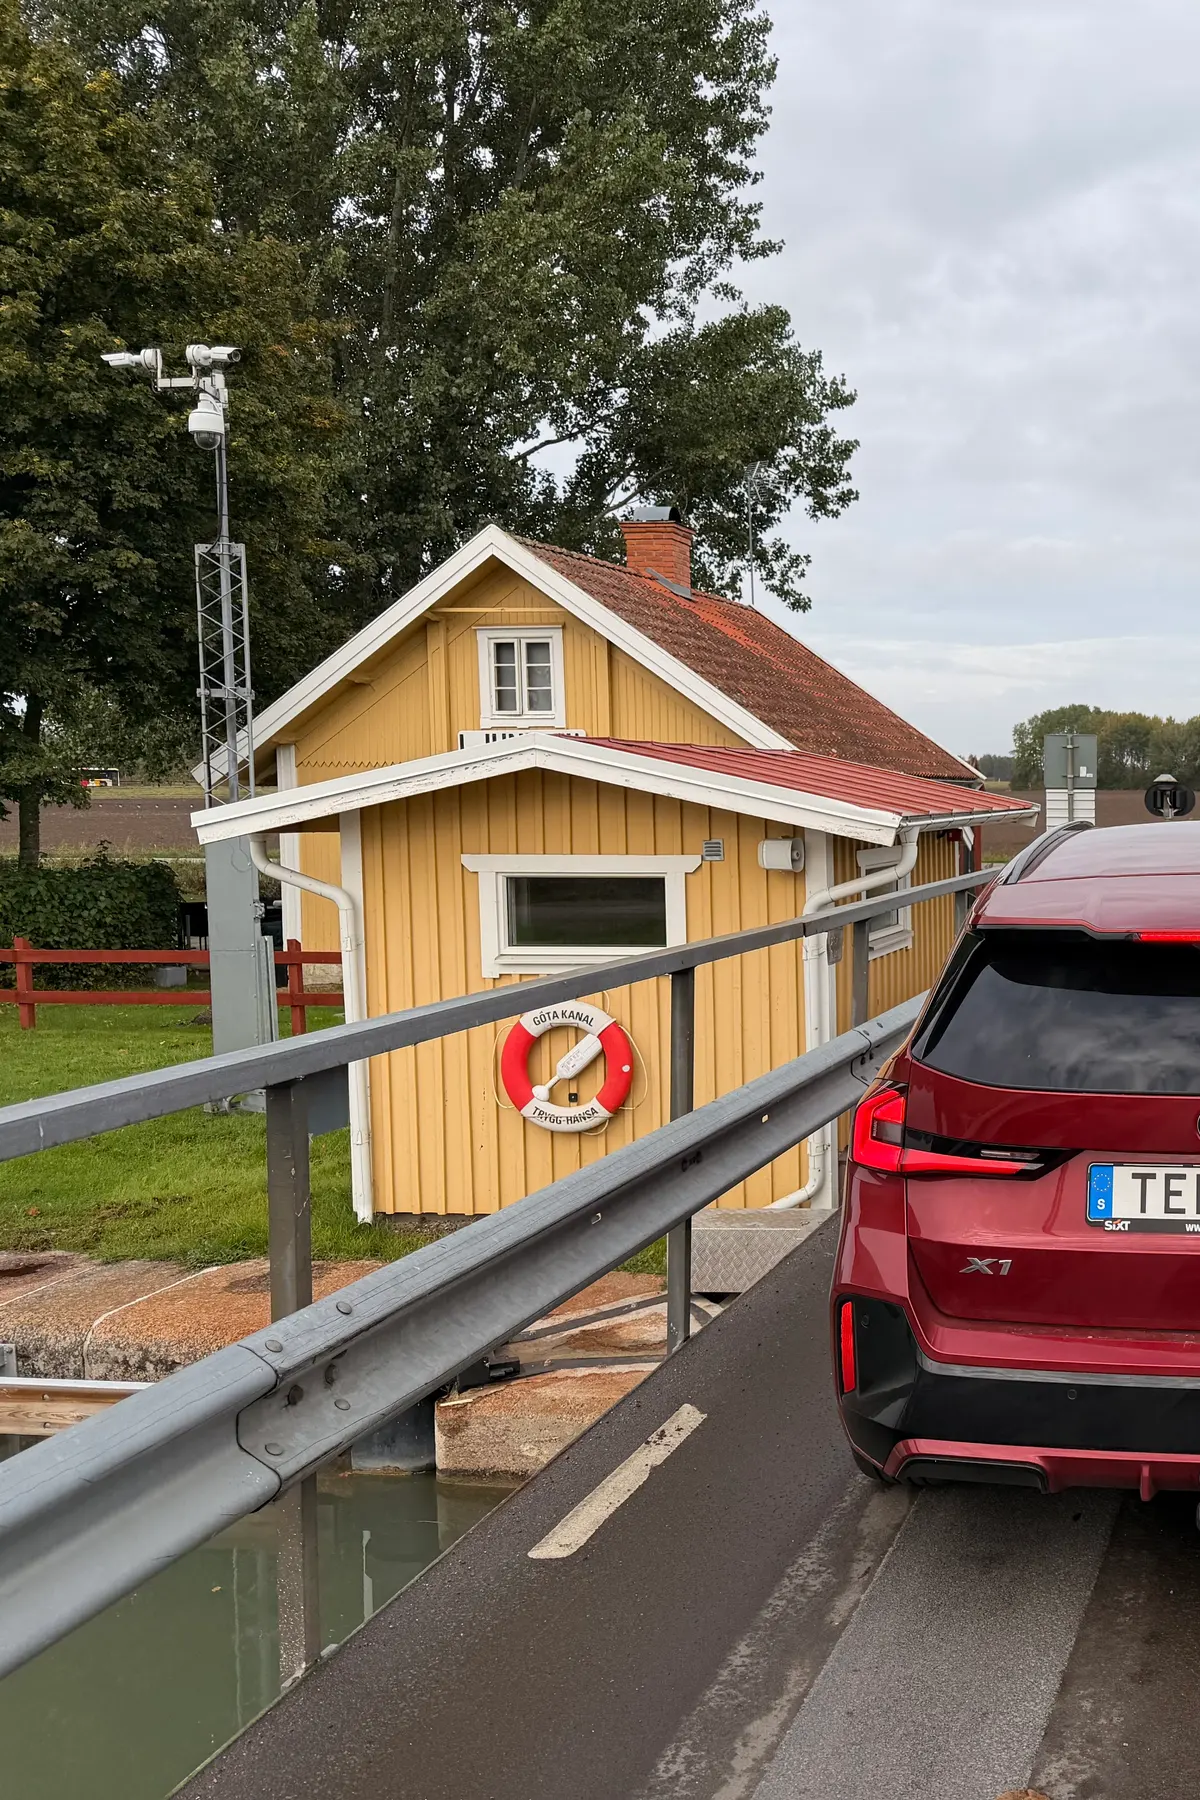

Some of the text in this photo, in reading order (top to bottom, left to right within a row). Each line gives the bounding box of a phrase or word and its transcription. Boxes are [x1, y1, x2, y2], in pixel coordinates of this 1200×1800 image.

[533, 1010, 594, 1026] GÖTA KANAL
[533, 1106, 598, 1124] TRYGG-HANSA
[1096, 1199, 1106, 1210] S
[959, 1257, 1012, 1275] X1
